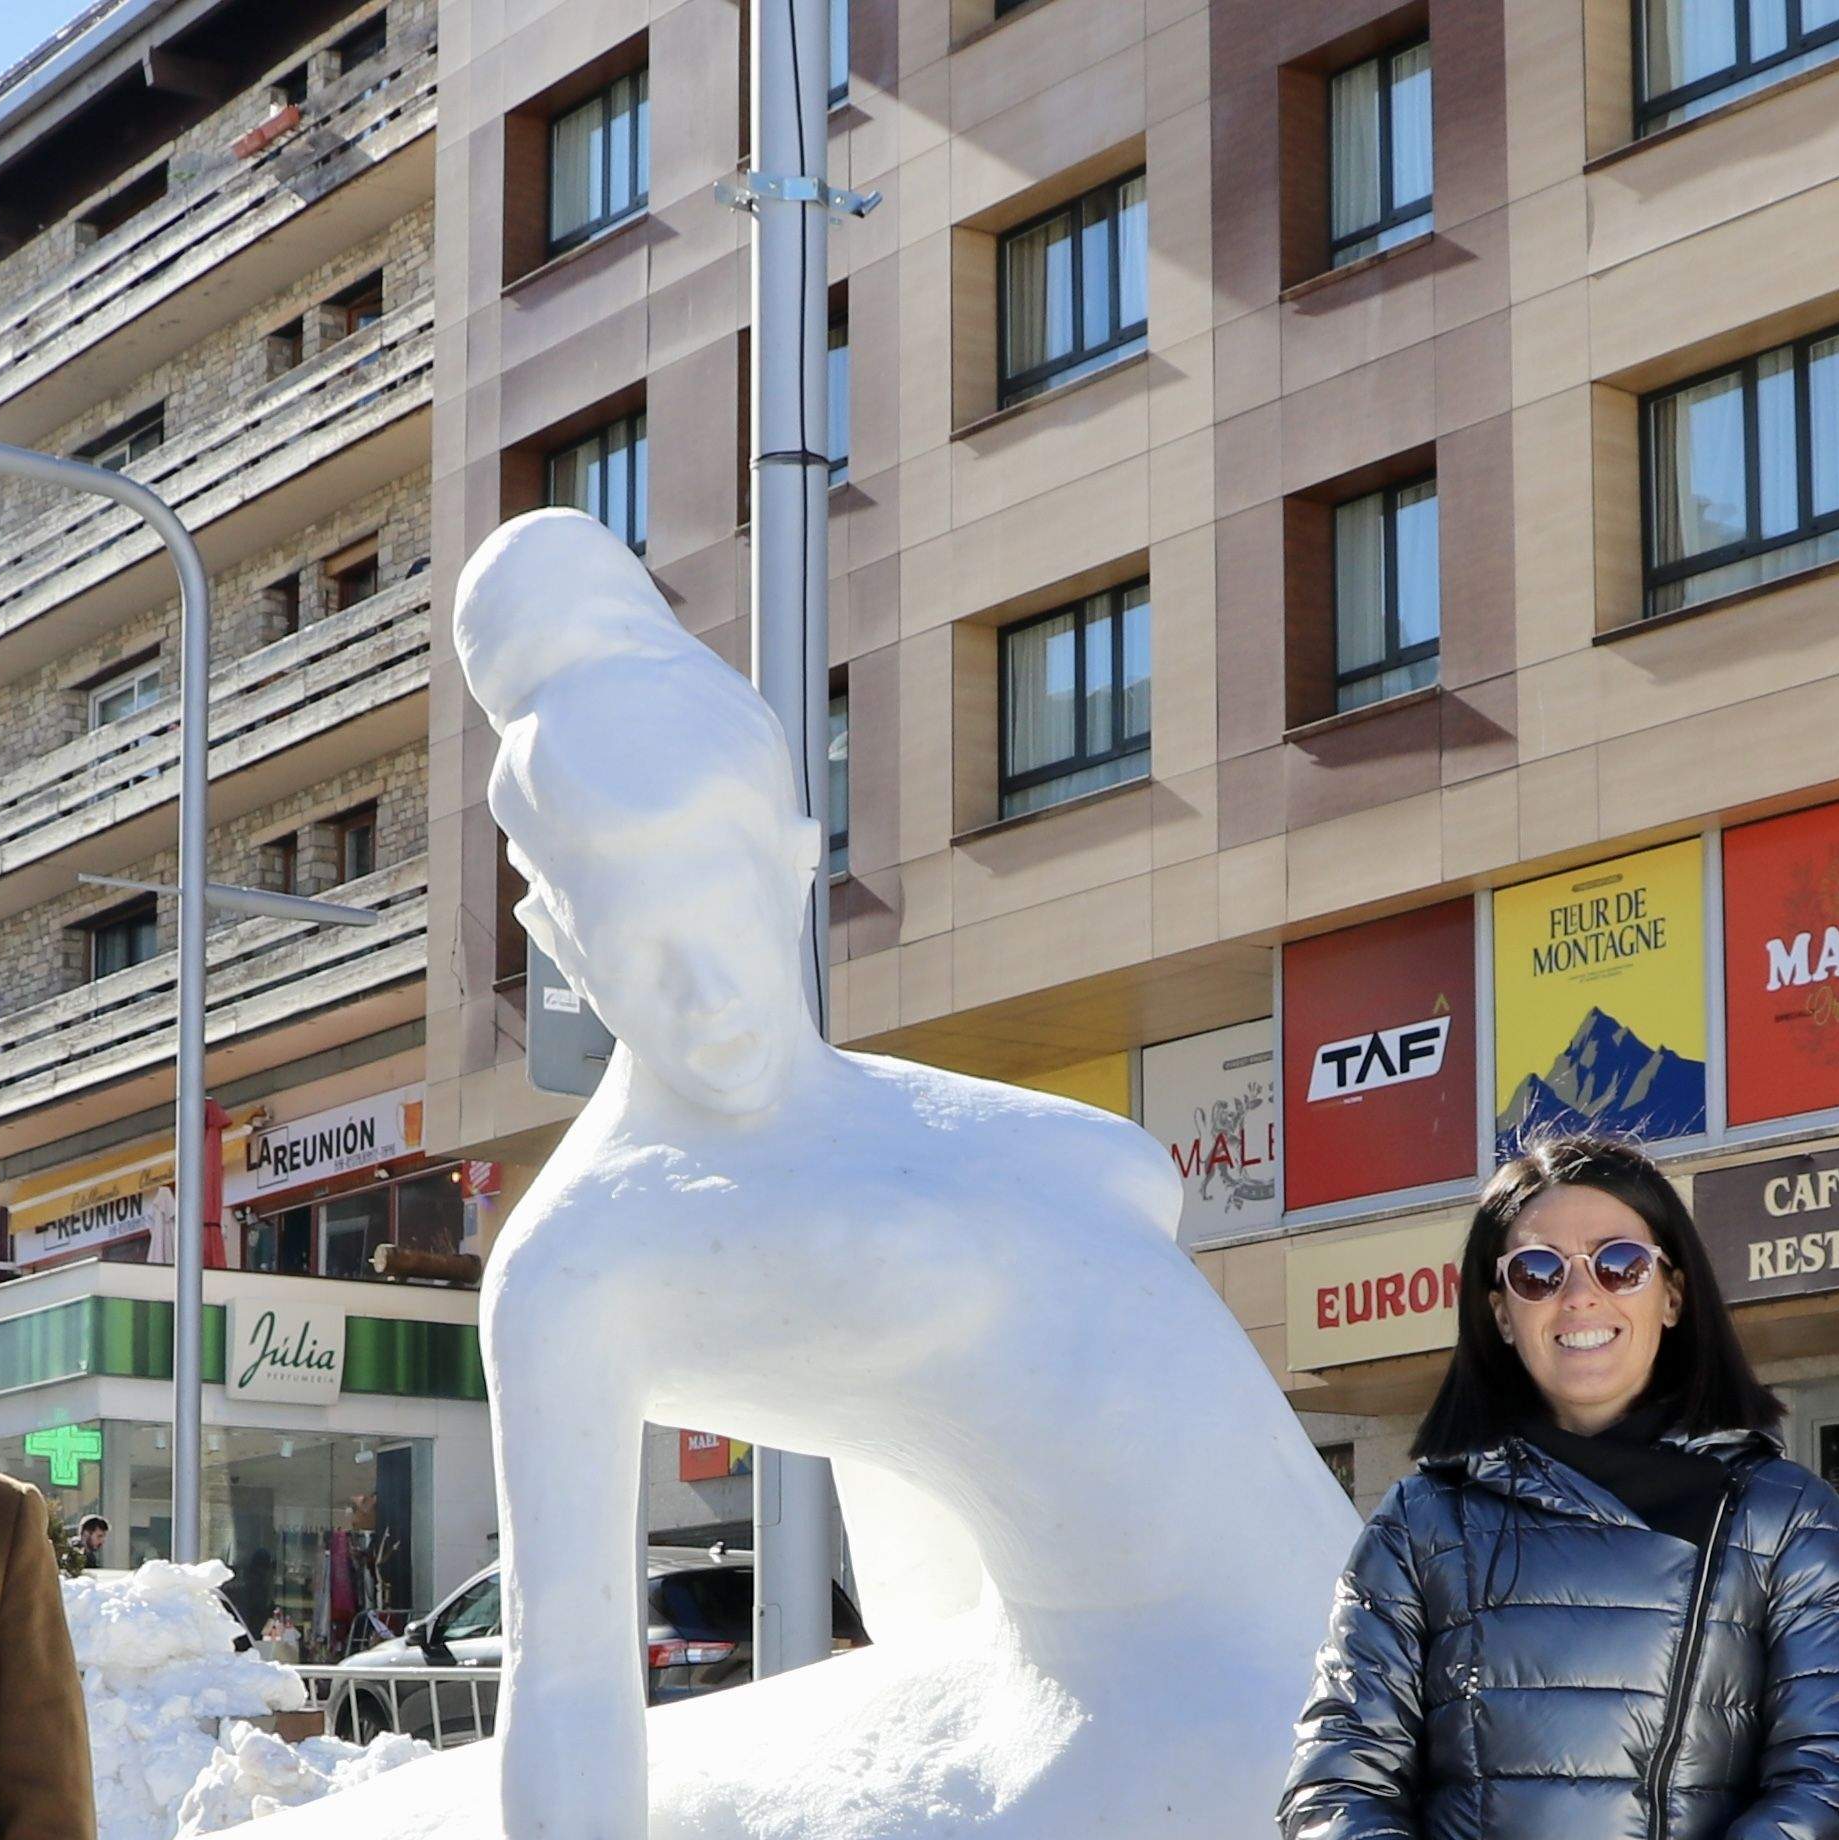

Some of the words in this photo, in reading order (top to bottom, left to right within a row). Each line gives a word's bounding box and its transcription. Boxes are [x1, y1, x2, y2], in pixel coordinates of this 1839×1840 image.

[1550, 898, 1610, 939] FLEUR
[1616, 887, 1648, 923] DE
[1533, 917, 1667, 977] MONTAGNE
[1322, 1027, 1440, 1088] TAF
[238, 1311, 336, 1389] Júlia
[266, 1372, 334, 1384] PERFUMERIA
